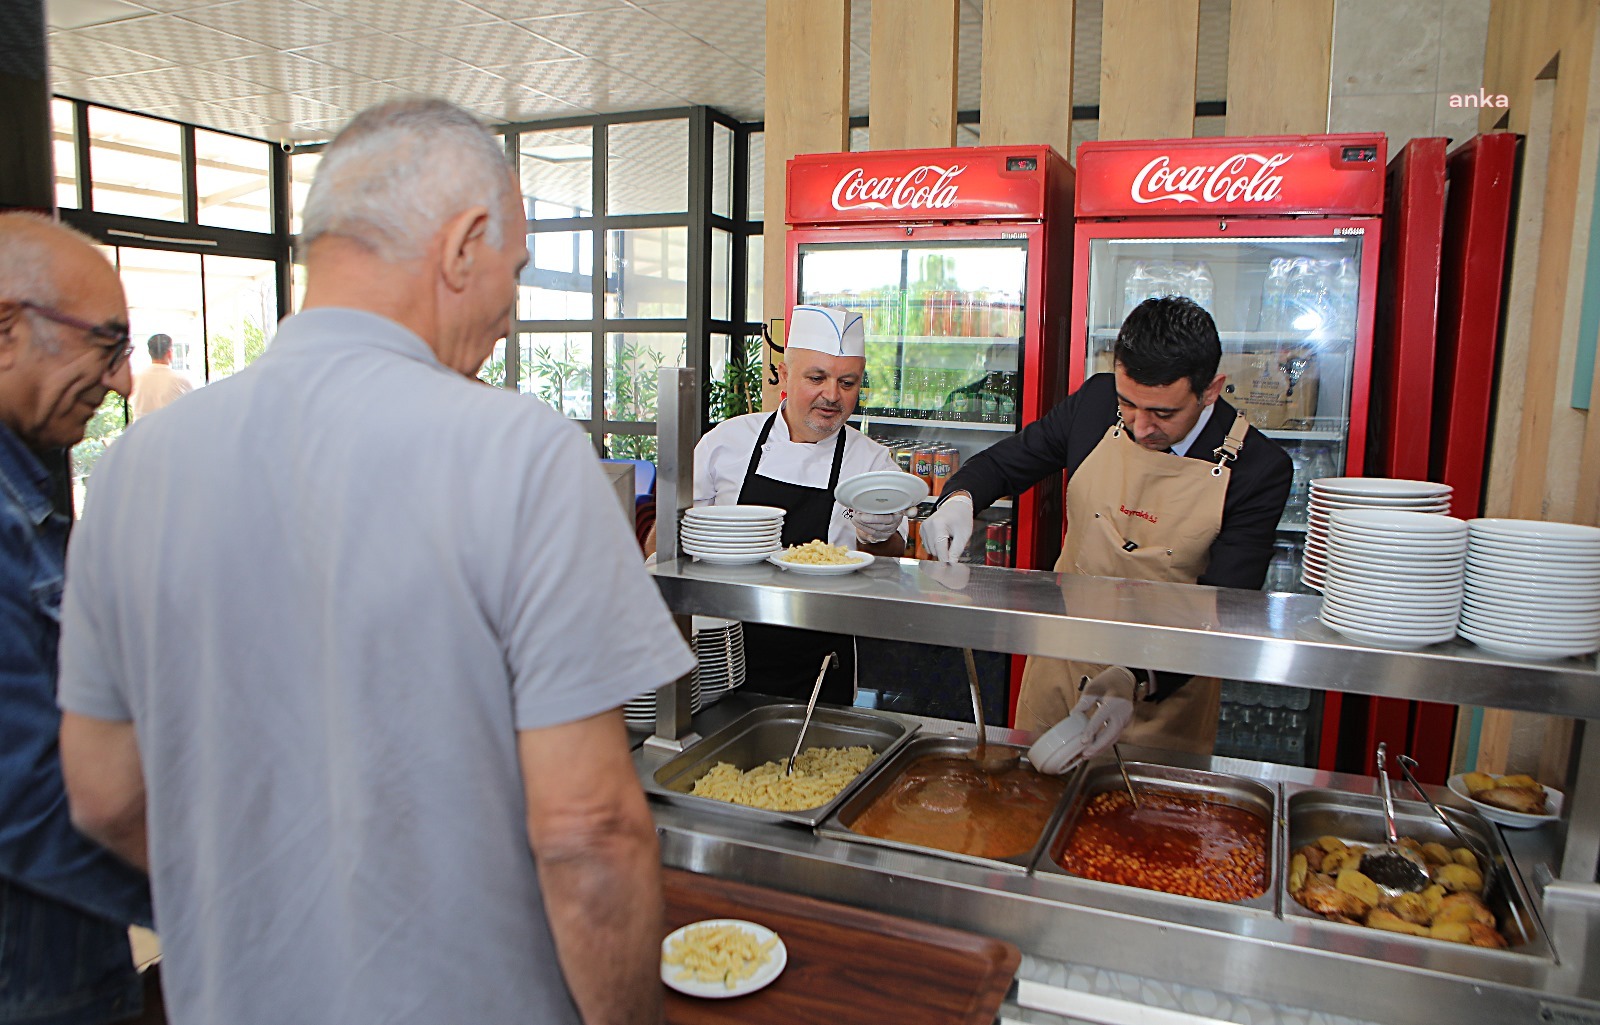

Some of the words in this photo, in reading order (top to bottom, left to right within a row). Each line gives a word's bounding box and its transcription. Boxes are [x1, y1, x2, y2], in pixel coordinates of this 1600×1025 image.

[831, 164, 968, 211] Coca-Cola
[1131, 153, 1294, 204] Coca-Cola
[915, 463, 931, 473] FANT
